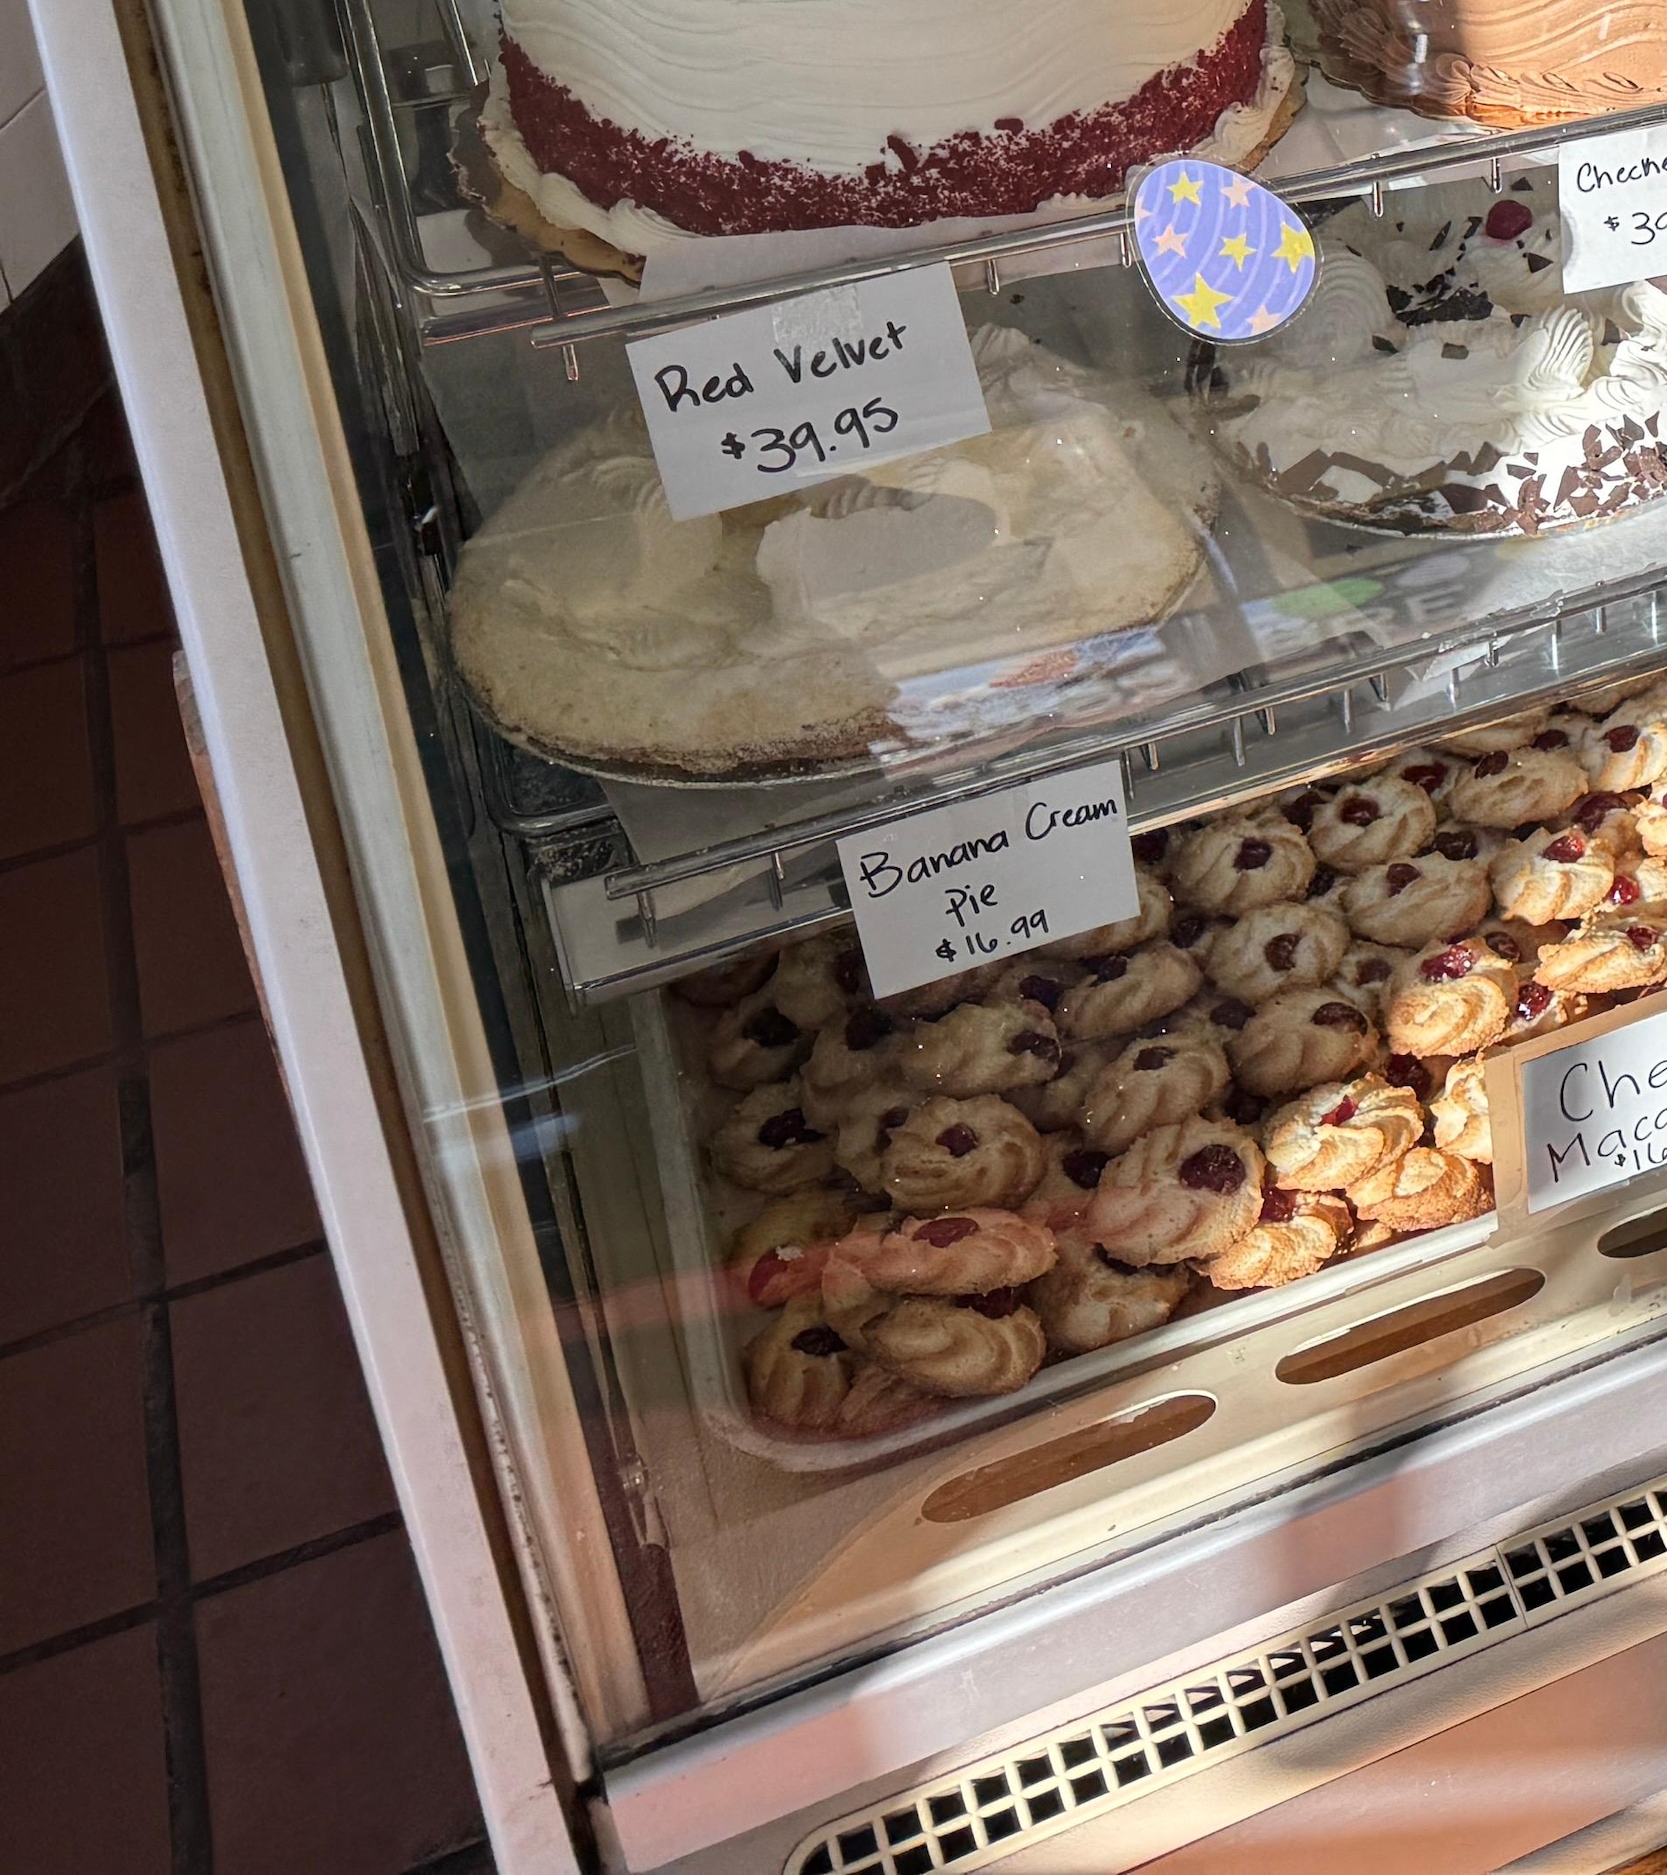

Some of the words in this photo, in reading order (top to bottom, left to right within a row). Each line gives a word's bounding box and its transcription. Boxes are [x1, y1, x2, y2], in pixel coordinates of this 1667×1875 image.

[654, 362, 754, 412] Red
[773, 320, 907, 384] Velvet
[720, 396, 899, 473] $39.95
[859, 829, 1010, 898] Banana
[1024, 797, 1118, 841] Cream
